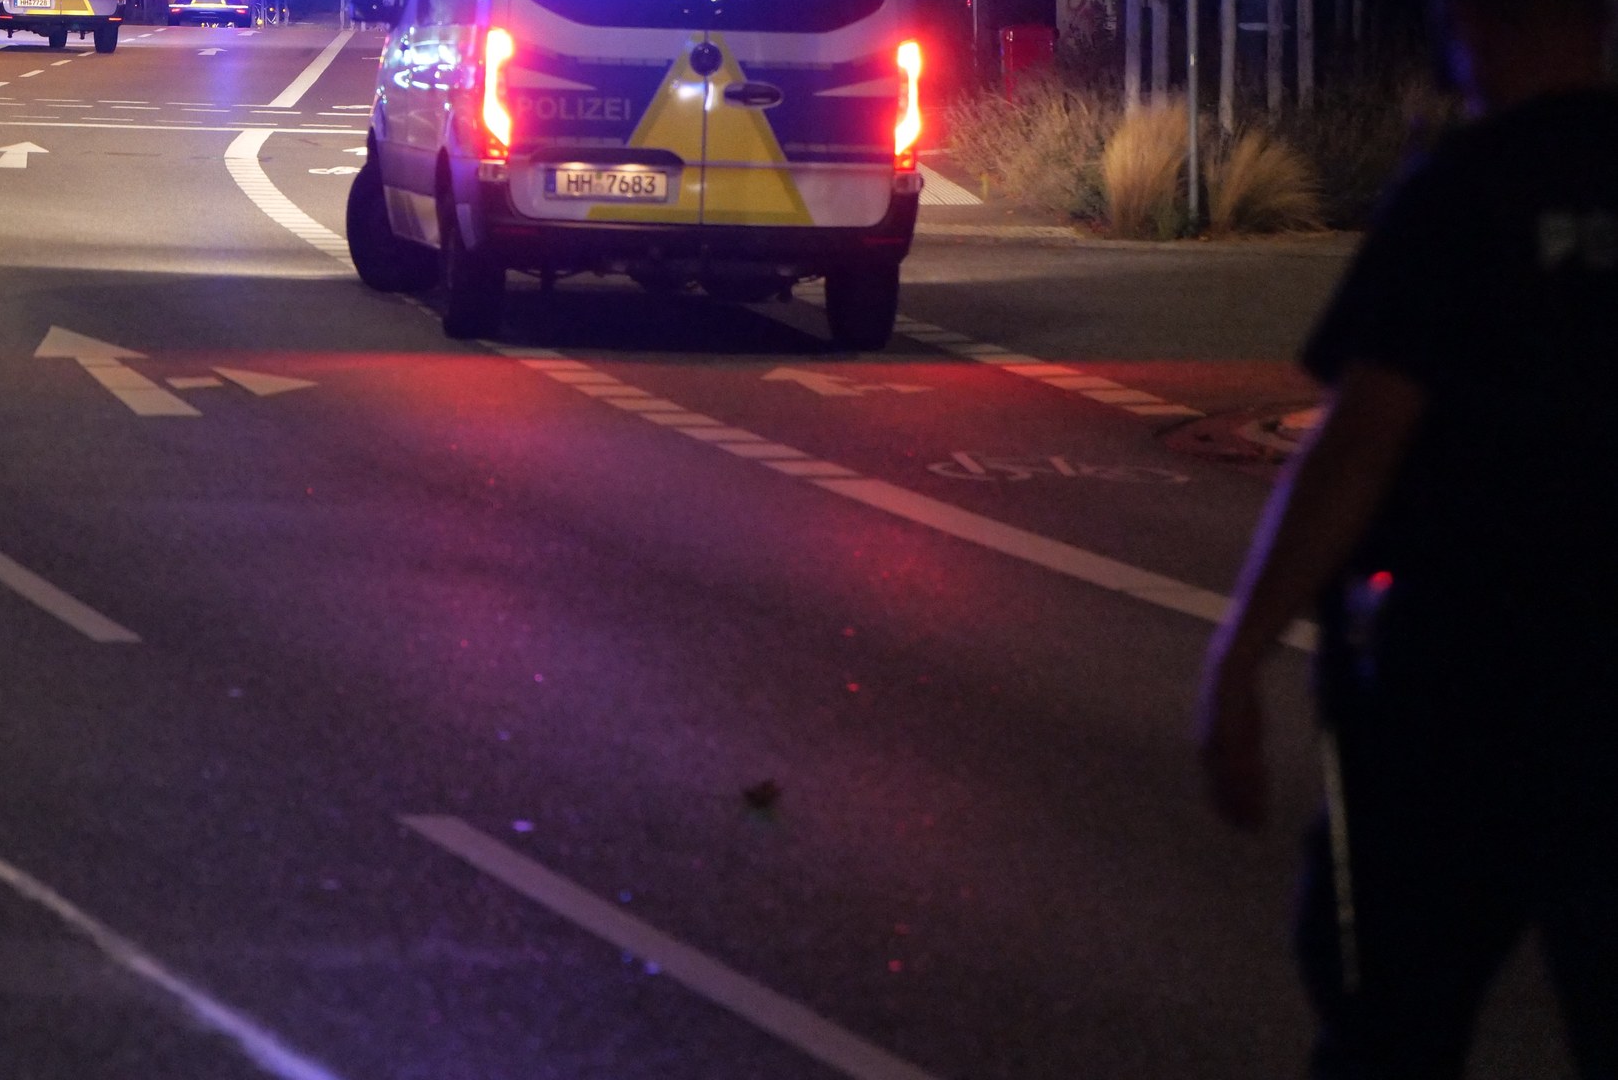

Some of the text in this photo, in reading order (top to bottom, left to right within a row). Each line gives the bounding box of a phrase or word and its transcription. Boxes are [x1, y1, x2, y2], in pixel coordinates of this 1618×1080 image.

[517, 97, 632, 121] POLIZEI
[567, 173, 656, 194] HH 7683
